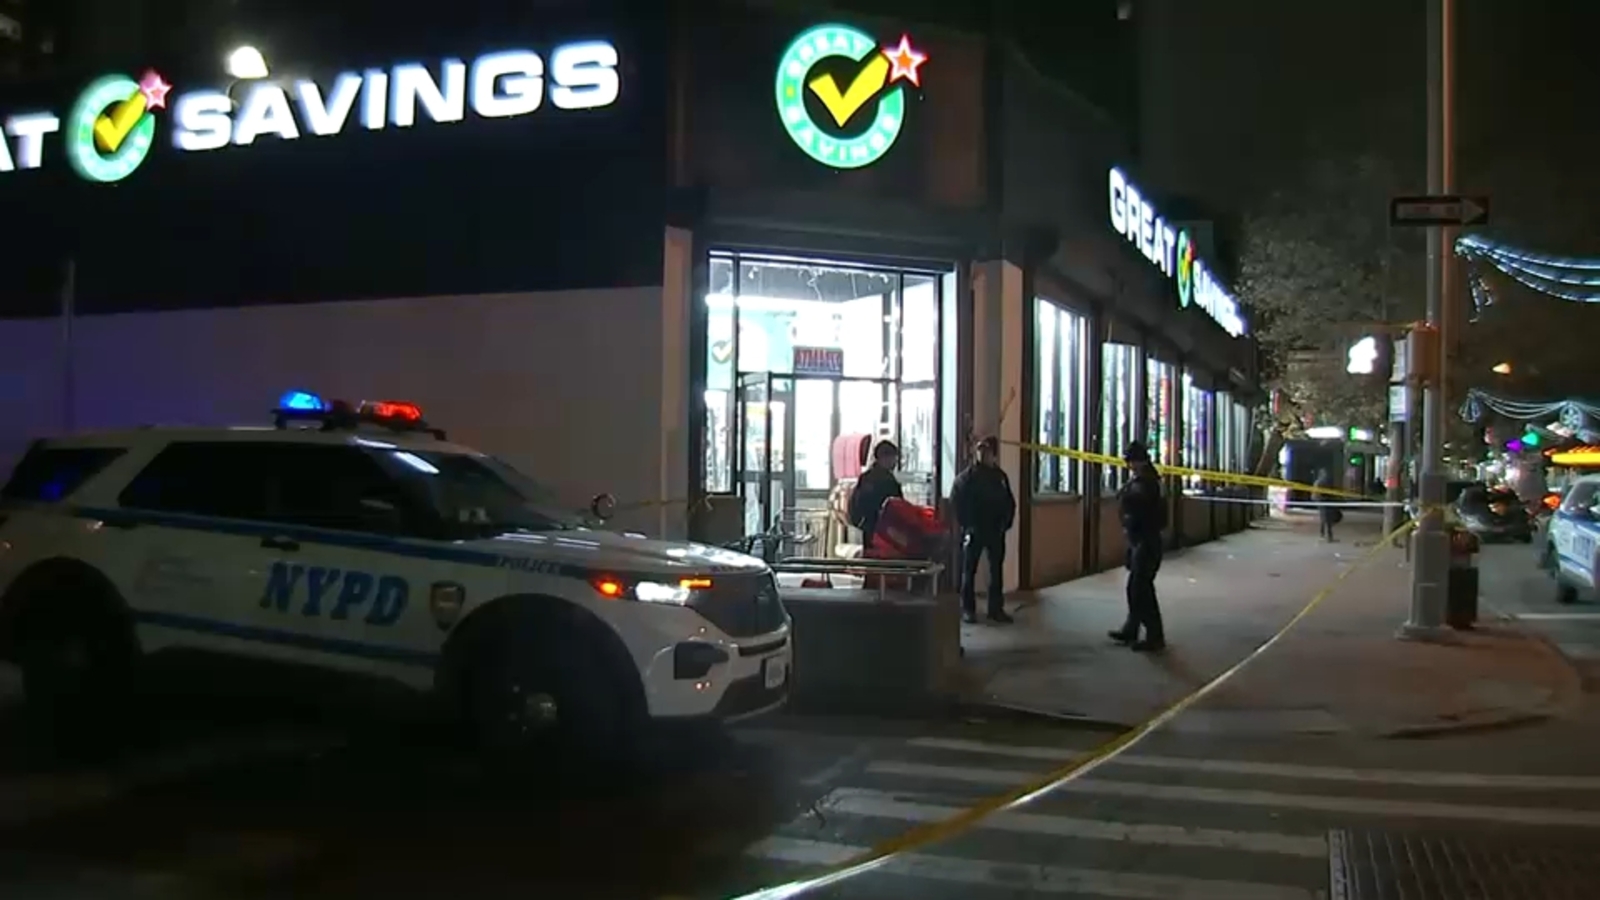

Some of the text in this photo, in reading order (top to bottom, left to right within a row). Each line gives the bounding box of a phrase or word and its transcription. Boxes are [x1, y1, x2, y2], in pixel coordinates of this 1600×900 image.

[173, 41, 619, 152] SAVINGS
[1109, 167, 1176, 278] GREAT
[259, 559, 410, 626] NYPD
[497, 555, 562, 576] POLICE
